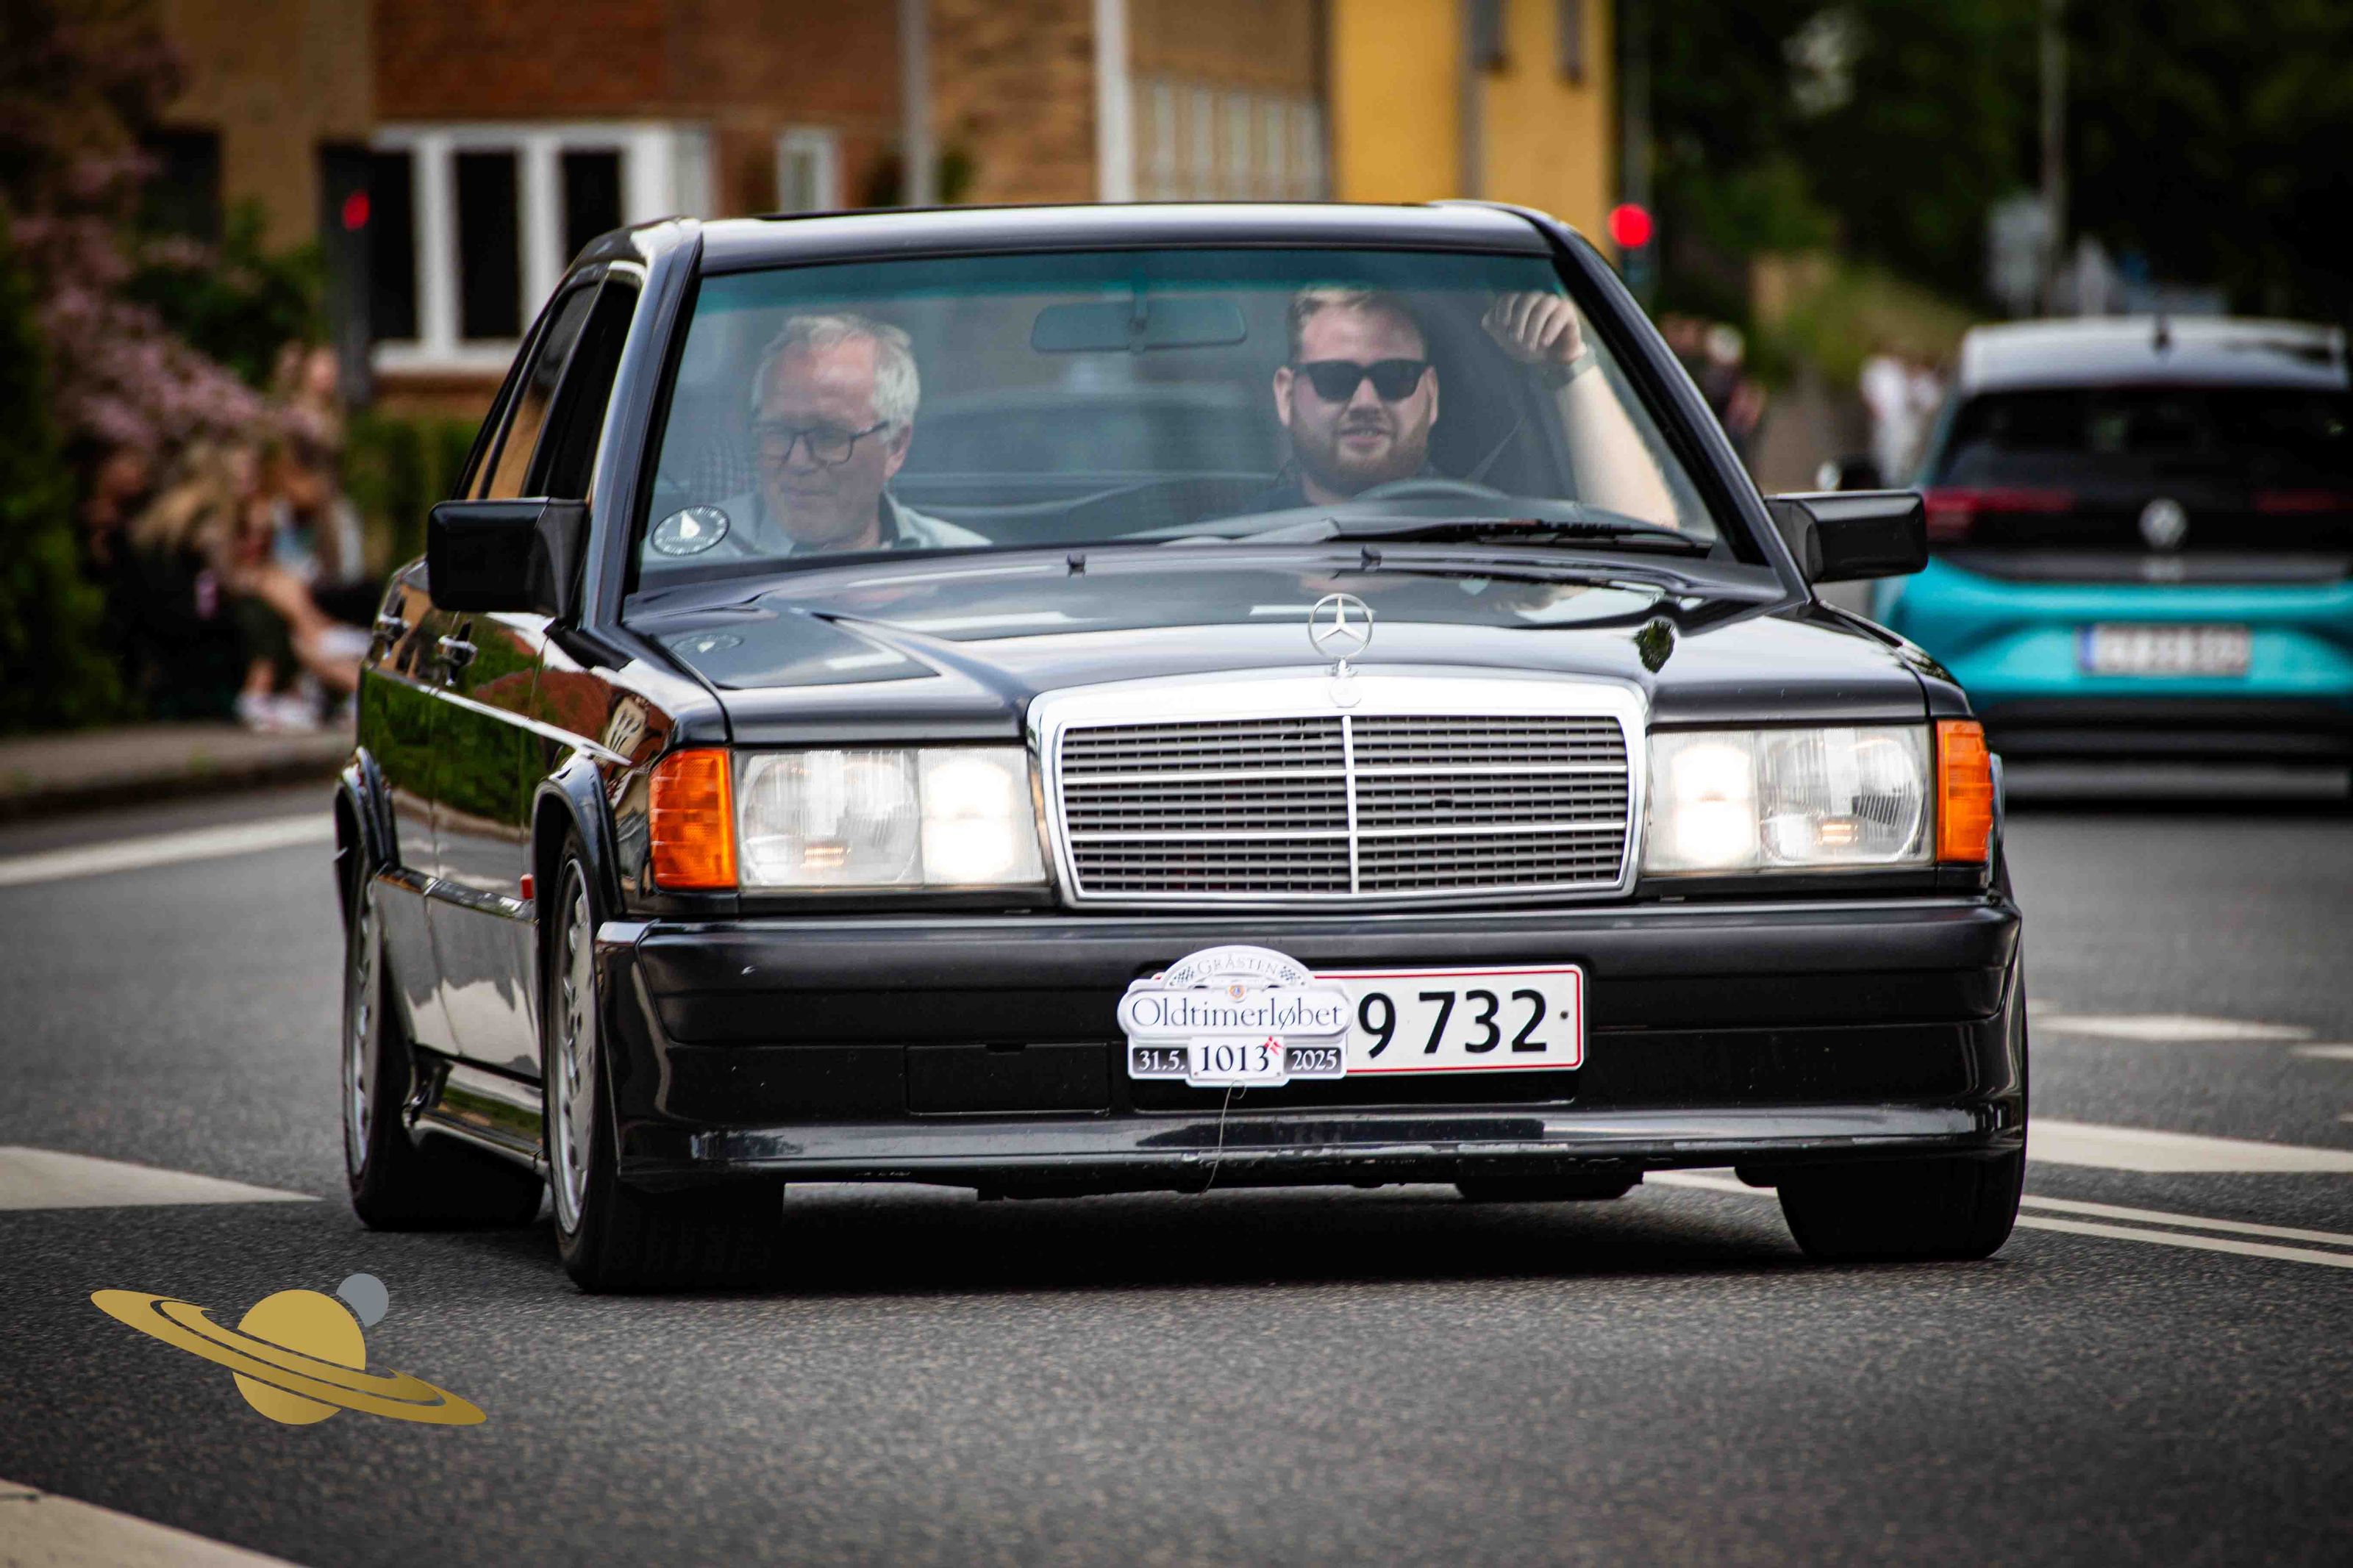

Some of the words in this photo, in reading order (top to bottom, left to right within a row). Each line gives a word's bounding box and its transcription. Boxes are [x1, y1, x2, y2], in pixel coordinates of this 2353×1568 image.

[1197, 953, 1278, 975] GRÅSTEN
[1132, 997, 1343, 1029] Oldtimerløbet
[1139, 1050, 1185, 1071] 31.5.
[1201, 1045, 1270, 1072] 1013
[1291, 1049, 1338, 1071] 2025
